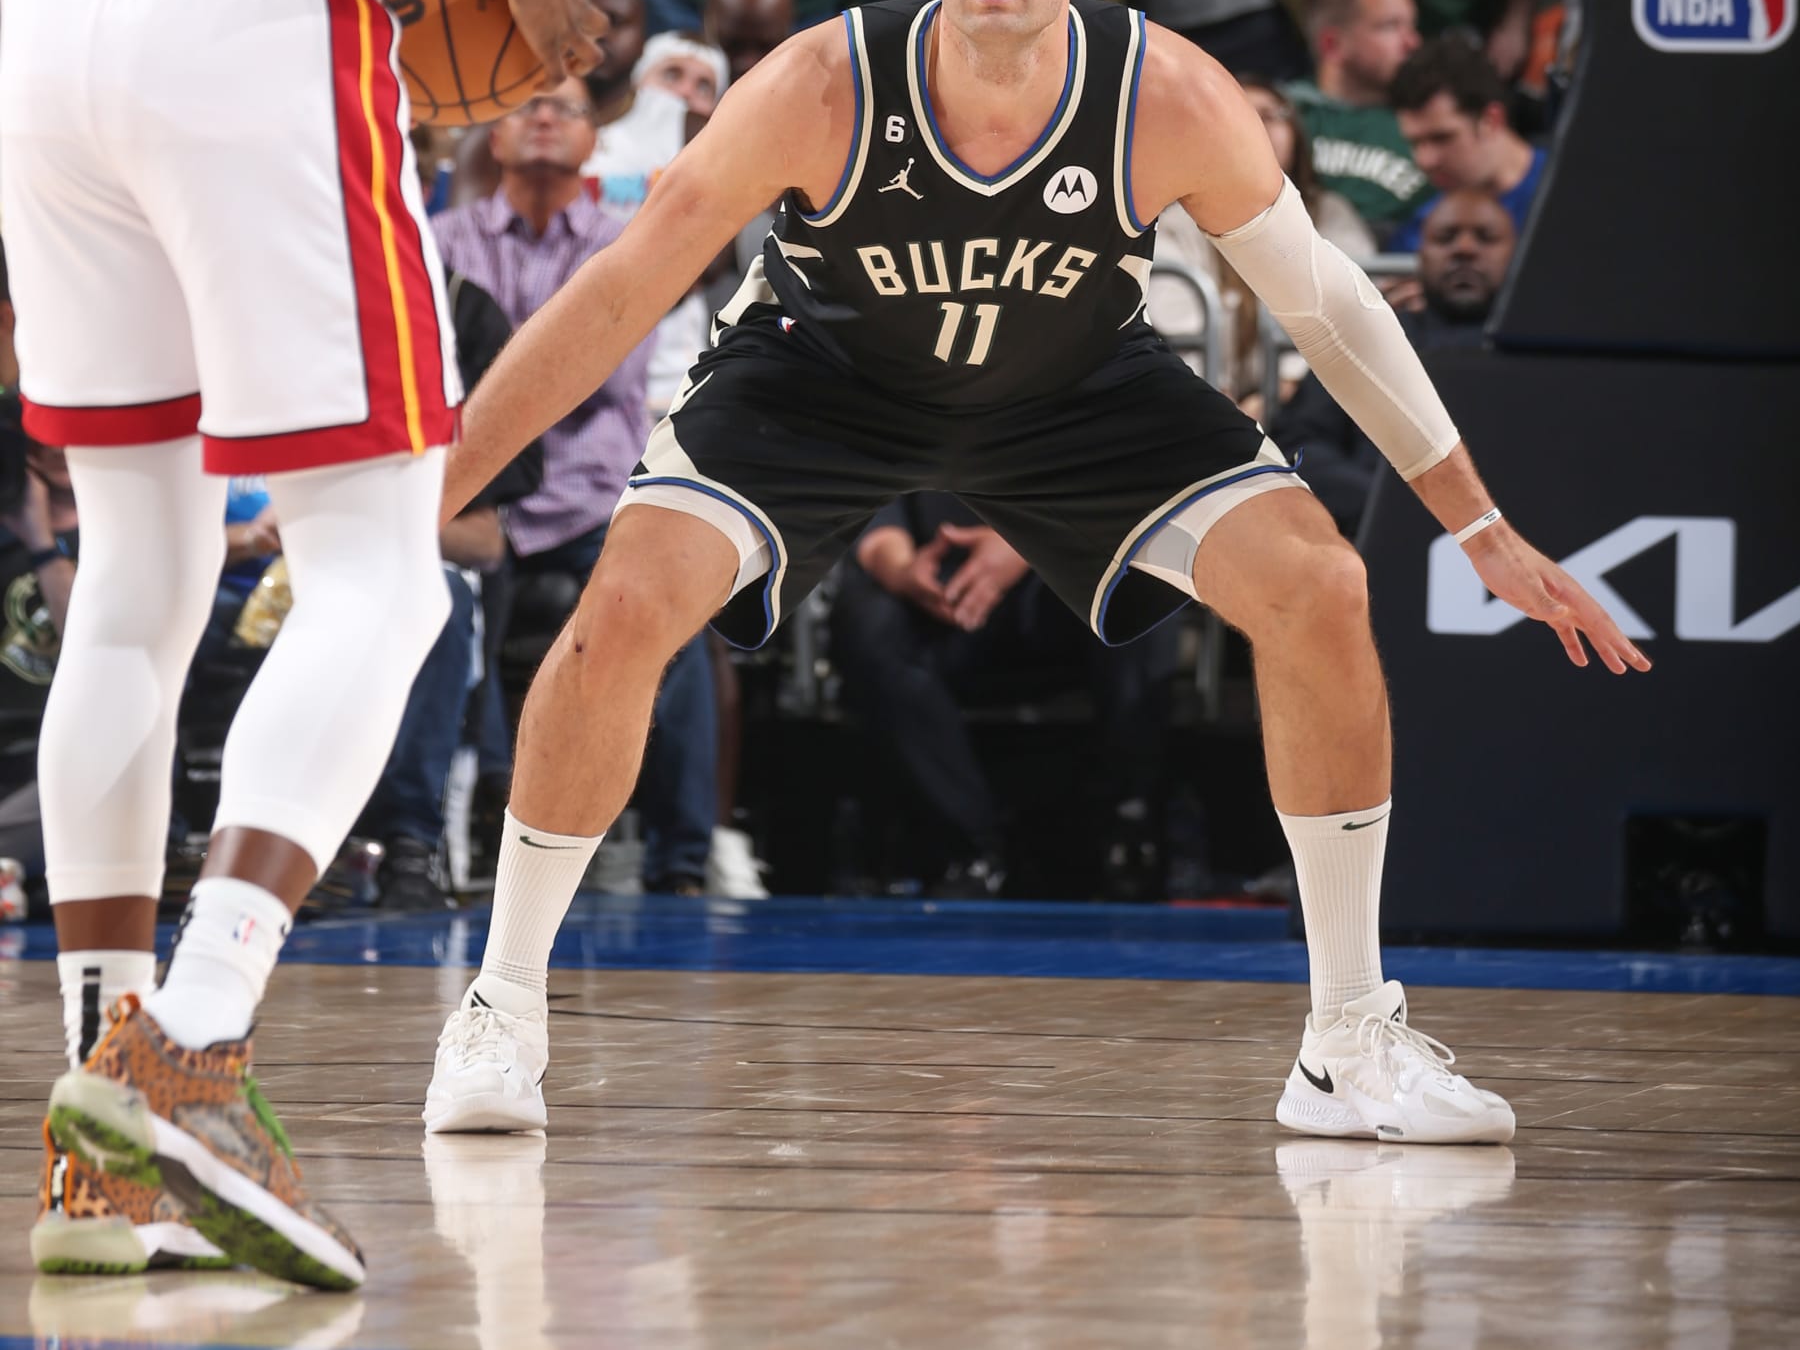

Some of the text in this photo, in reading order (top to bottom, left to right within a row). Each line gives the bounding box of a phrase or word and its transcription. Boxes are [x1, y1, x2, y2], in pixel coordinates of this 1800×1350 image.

[885, 114, 906, 144] 6
[856, 236, 1100, 299] BUCKS
[933, 301, 1003, 366] 11
[1426, 515, 1800, 643] KI
